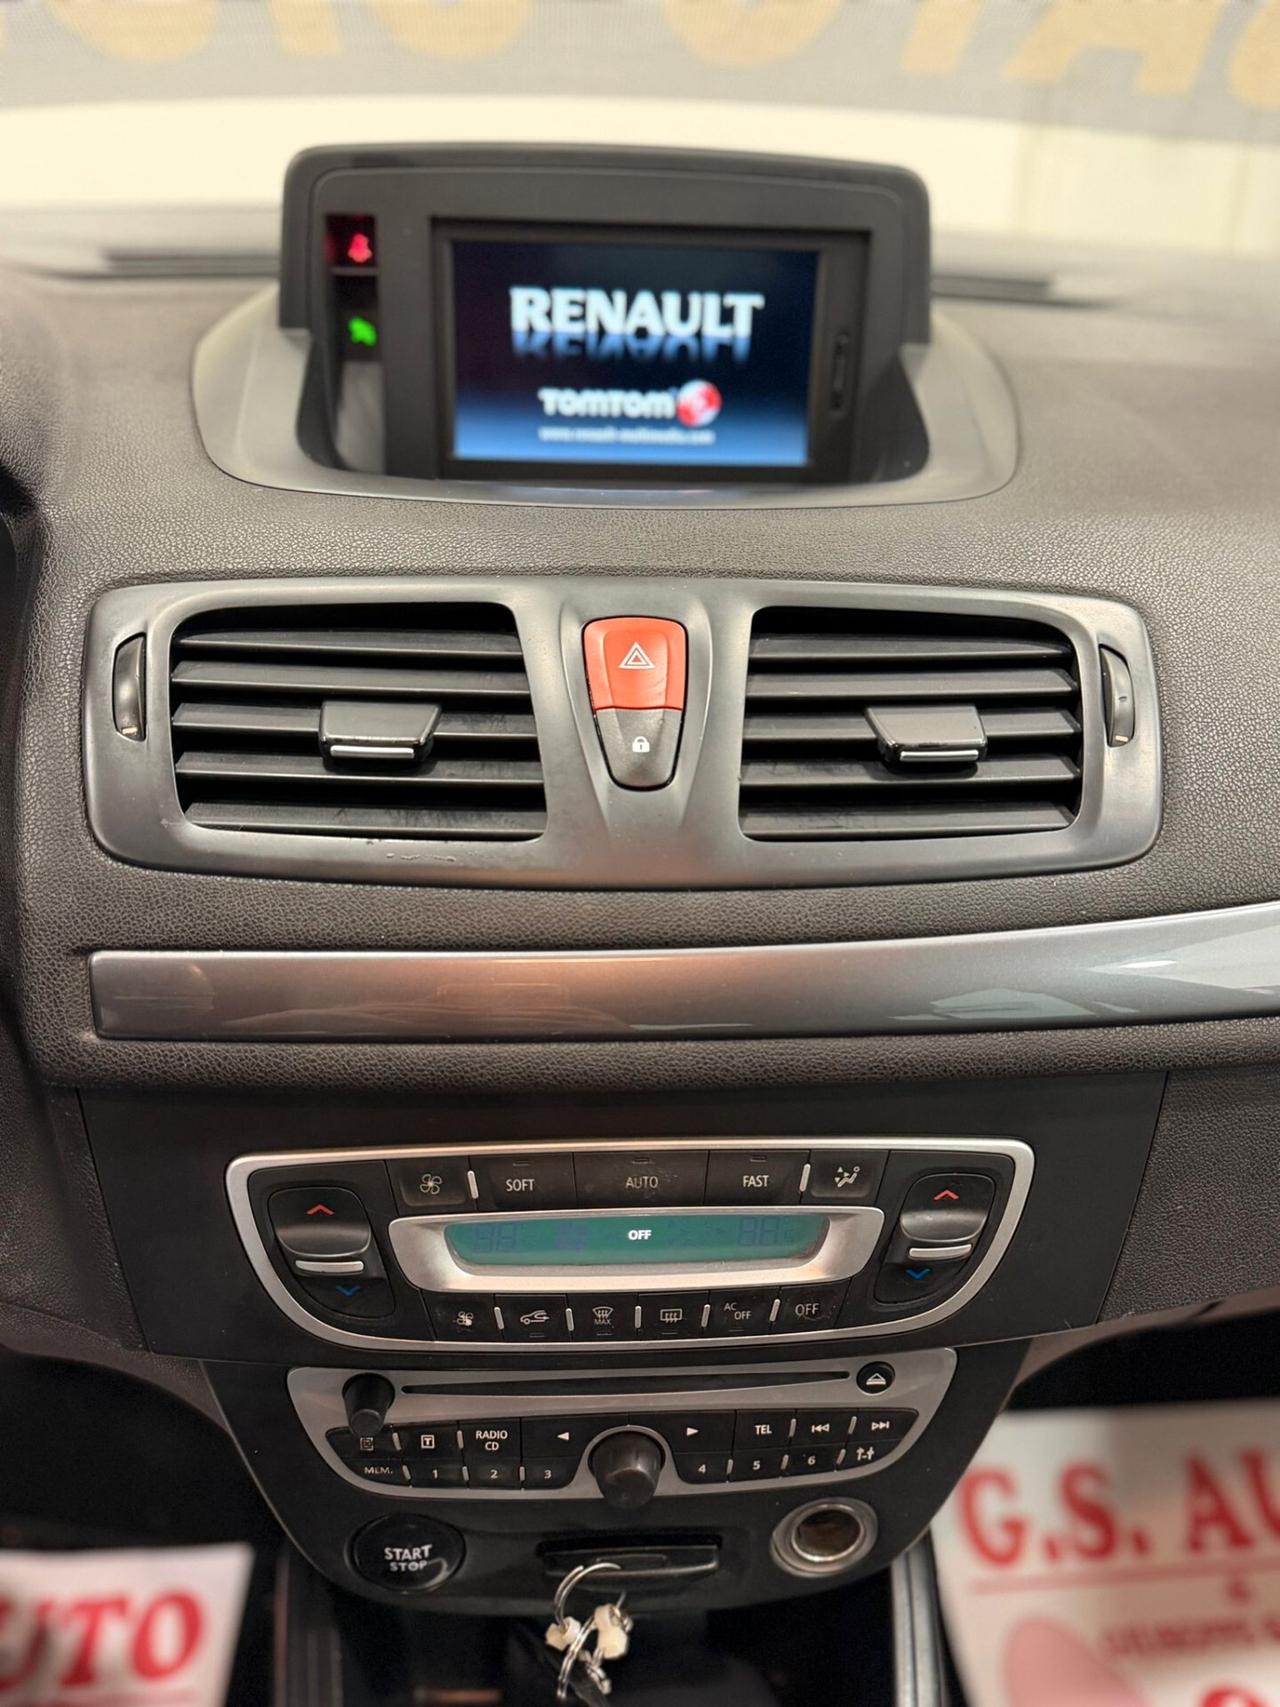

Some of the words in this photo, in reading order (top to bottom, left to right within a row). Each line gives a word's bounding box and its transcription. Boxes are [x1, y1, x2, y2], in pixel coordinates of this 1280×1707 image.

[509, 286, 764, 339] RENAULT
[505, 1178, 535, 1192] SOFT
[625, 1175, 658, 1189] AUTO
[742, 1174, 769, 1188] FAST
[627, 1229, 652, 1241] OFF
[723, 1302, 737, 1312] AC
[794, 1303, 820, 1315] OFF
[734, 1311, 752, 1320] OFF
[755, 1424, 772, 1435] TEL
[475, 1430, 508, 1441] RADIO
[484, 1441, 500, 1451] CD
[753, 1460, 761, 1471] 5
[807, 1455, 816, 1466] 6
[432, 1469, 438, 1479] 1
[490, 1469, 498, 1479] 2
[544, 1469, 552, 1479] 3
[698, 1463, 707, 1474] 4
[959, 1461, 1150, 1568] G.S.
[384, 1544, 433, 1561] START
[390, 1559, 428, 1573] STOP
